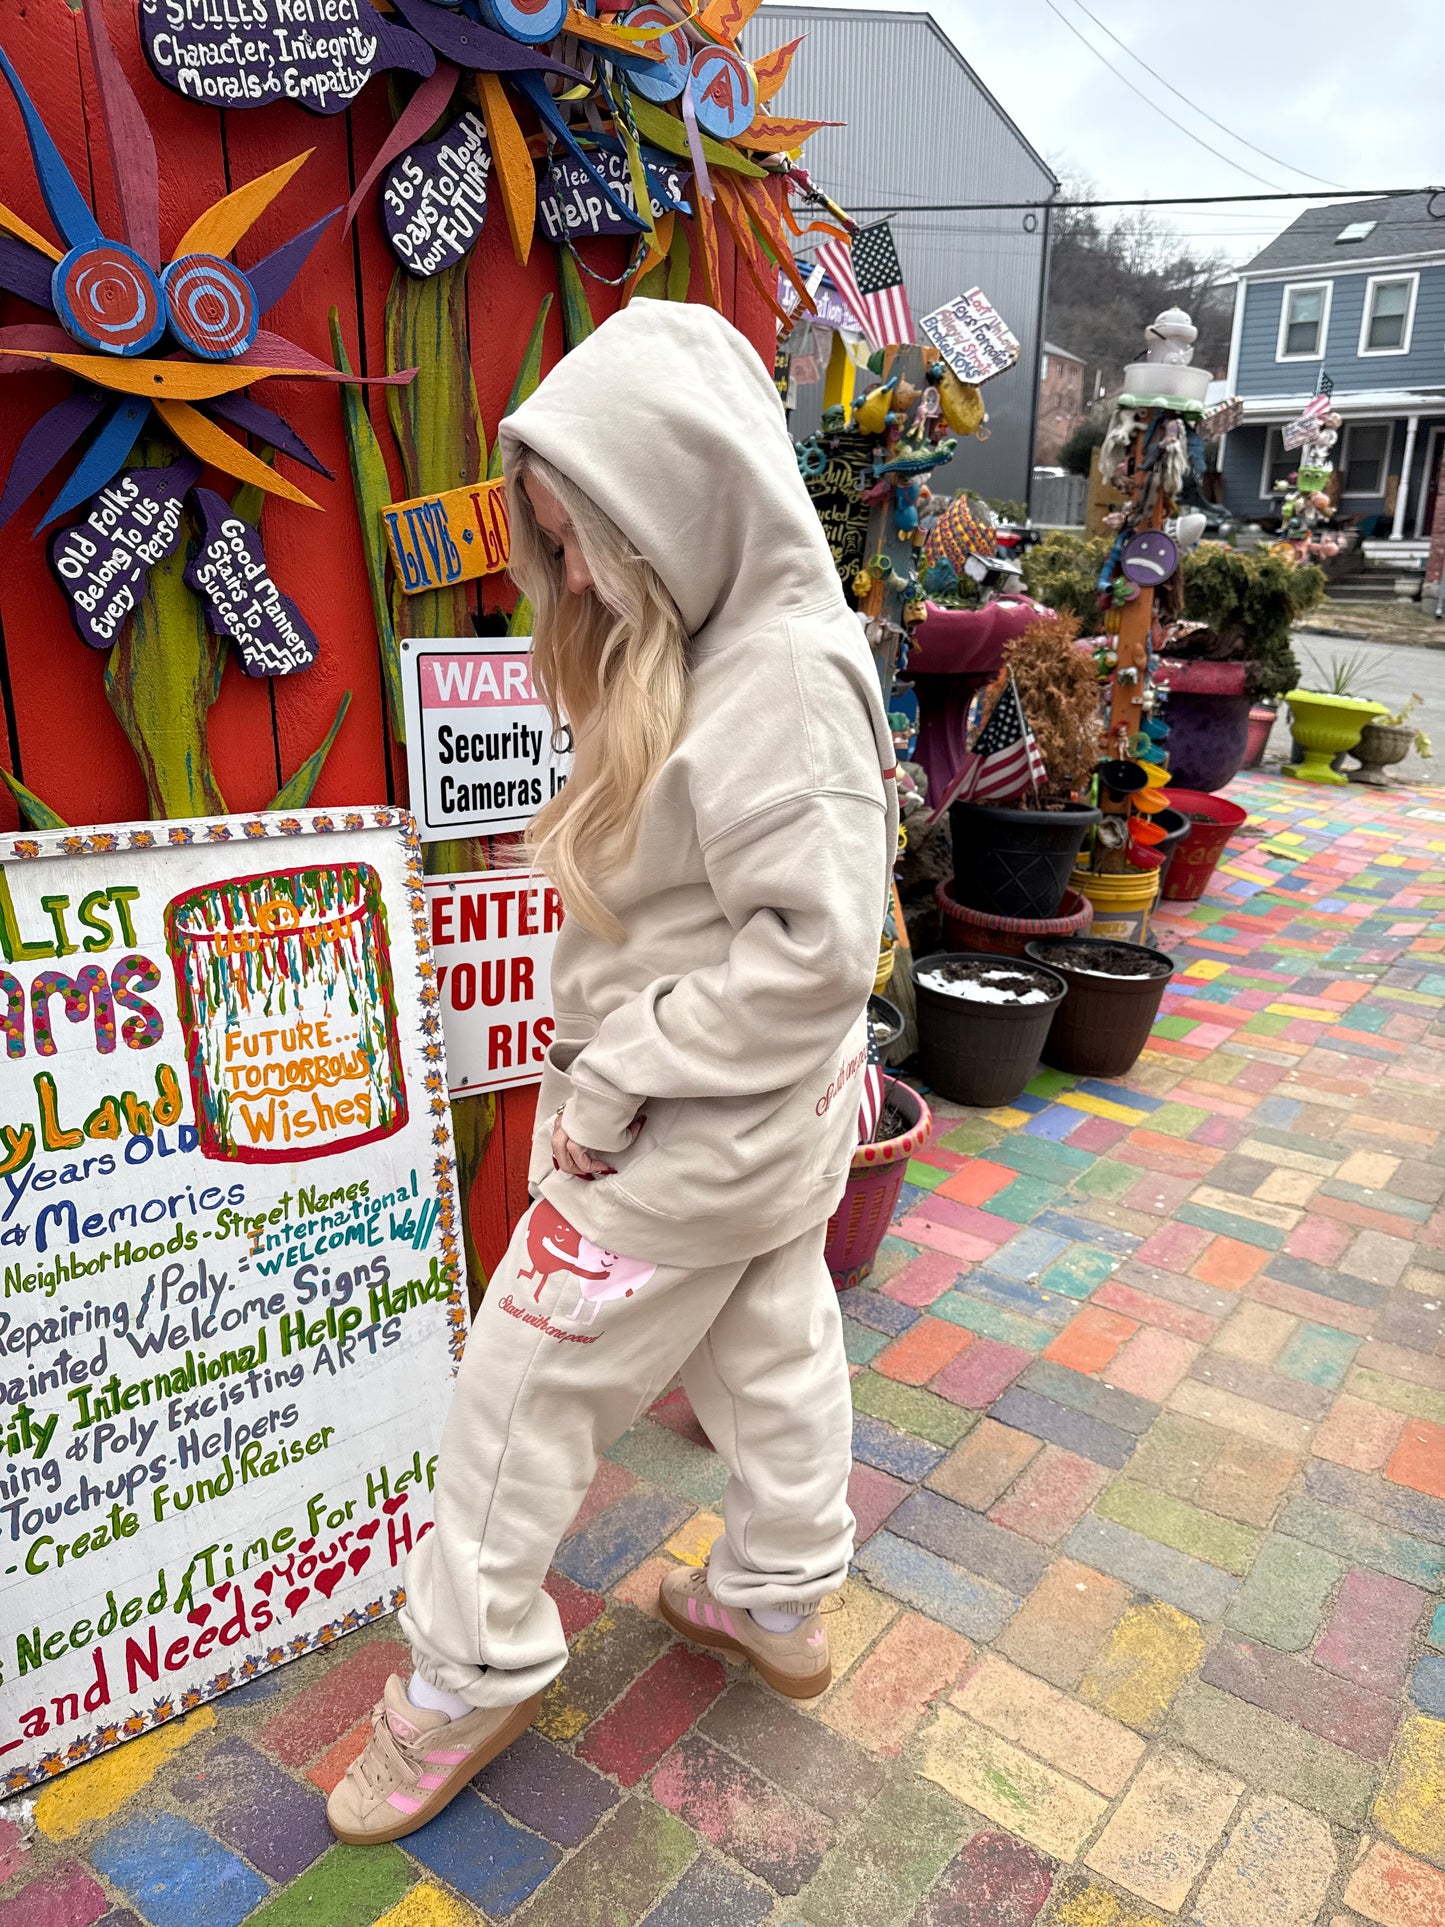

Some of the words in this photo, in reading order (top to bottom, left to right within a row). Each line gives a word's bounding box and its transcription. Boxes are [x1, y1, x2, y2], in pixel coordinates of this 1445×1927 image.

[153, 30, 275, 68] Character,
[273, 27, 377, 66] Integrity
[166, 0, 268, 24] SMILES
[177, 68, 262, 98] Morals
[285, 67, 371, 108] Empathy
[384, 156, 424, 215] 365
[392, 200, 438, 256] Days
[437, 112, 488, 172] Mould
[410, 240, 446, 276] Your
[438, 148, 492, 254] FUTURE
[553, 164, 606, 187] Pleae
[541, 189, 603, 237] Help
[57, 531, 97, 579] Old
[88, 477, 139, 537] Folks
[74, 548, 132, 612] Belong
[111, 526, 142, 550] To
[131, 497, 160, 526] Us
[136, 497, 184, 565] Person
[385, 498, 463, 591] LIVE
[196, 563, 253, 645] Success
[207, 540, 248, 602] Stairs
[242, 598, 263, 628] To
[220, 518, 266, 581] Good
[254, 578, 314, 665] Manners
[432, 661, 538, 702] WAR
[438, 722, 543, 765] Security
[440, 775, 542, 814] Cameras
[0, 864, 140, 963] LIST
[431, 887, 567, 946] ENTER
[225, 1049, 370, 1090] TOMORROWS
[33, 1063, 183, 1152] Land
[124, 1124, 199, 1165] OLD
[239, 1092, 371, 1143] Wishes
[35, 1184, 245, 1253] Memories
[247, 1168, 419, 1257] International
[299, 1179, 369, 1217] Names
[256, 1212, 384, 1276] WELCOME
[389, 1197, 441, 1251] Wall
[126, 1292, 286, 1358] Welcome
[293, 1255, 391, 1306] Signs
[498, 1295, 526, 1318] Start
[522, 1313, 551, 1331] with
[0, 1402, 59, 1459] ity
[280, 1304, 362, 1357] Help
[368, 1256, 455, 1323] Hands
[93, 1416, 158, 1463] Poly
[313, 1316, 402, 1377] ARTS
[16, 1568, 167, 1677] Needed
[193, 1527, 297, 1587] Time
[306, 1492, 357, 1538] For
[0, 1646, 111, 1756] and
[126, 1584, 273, 1694] Needs
[272, 1531, 354, 1587] Your
